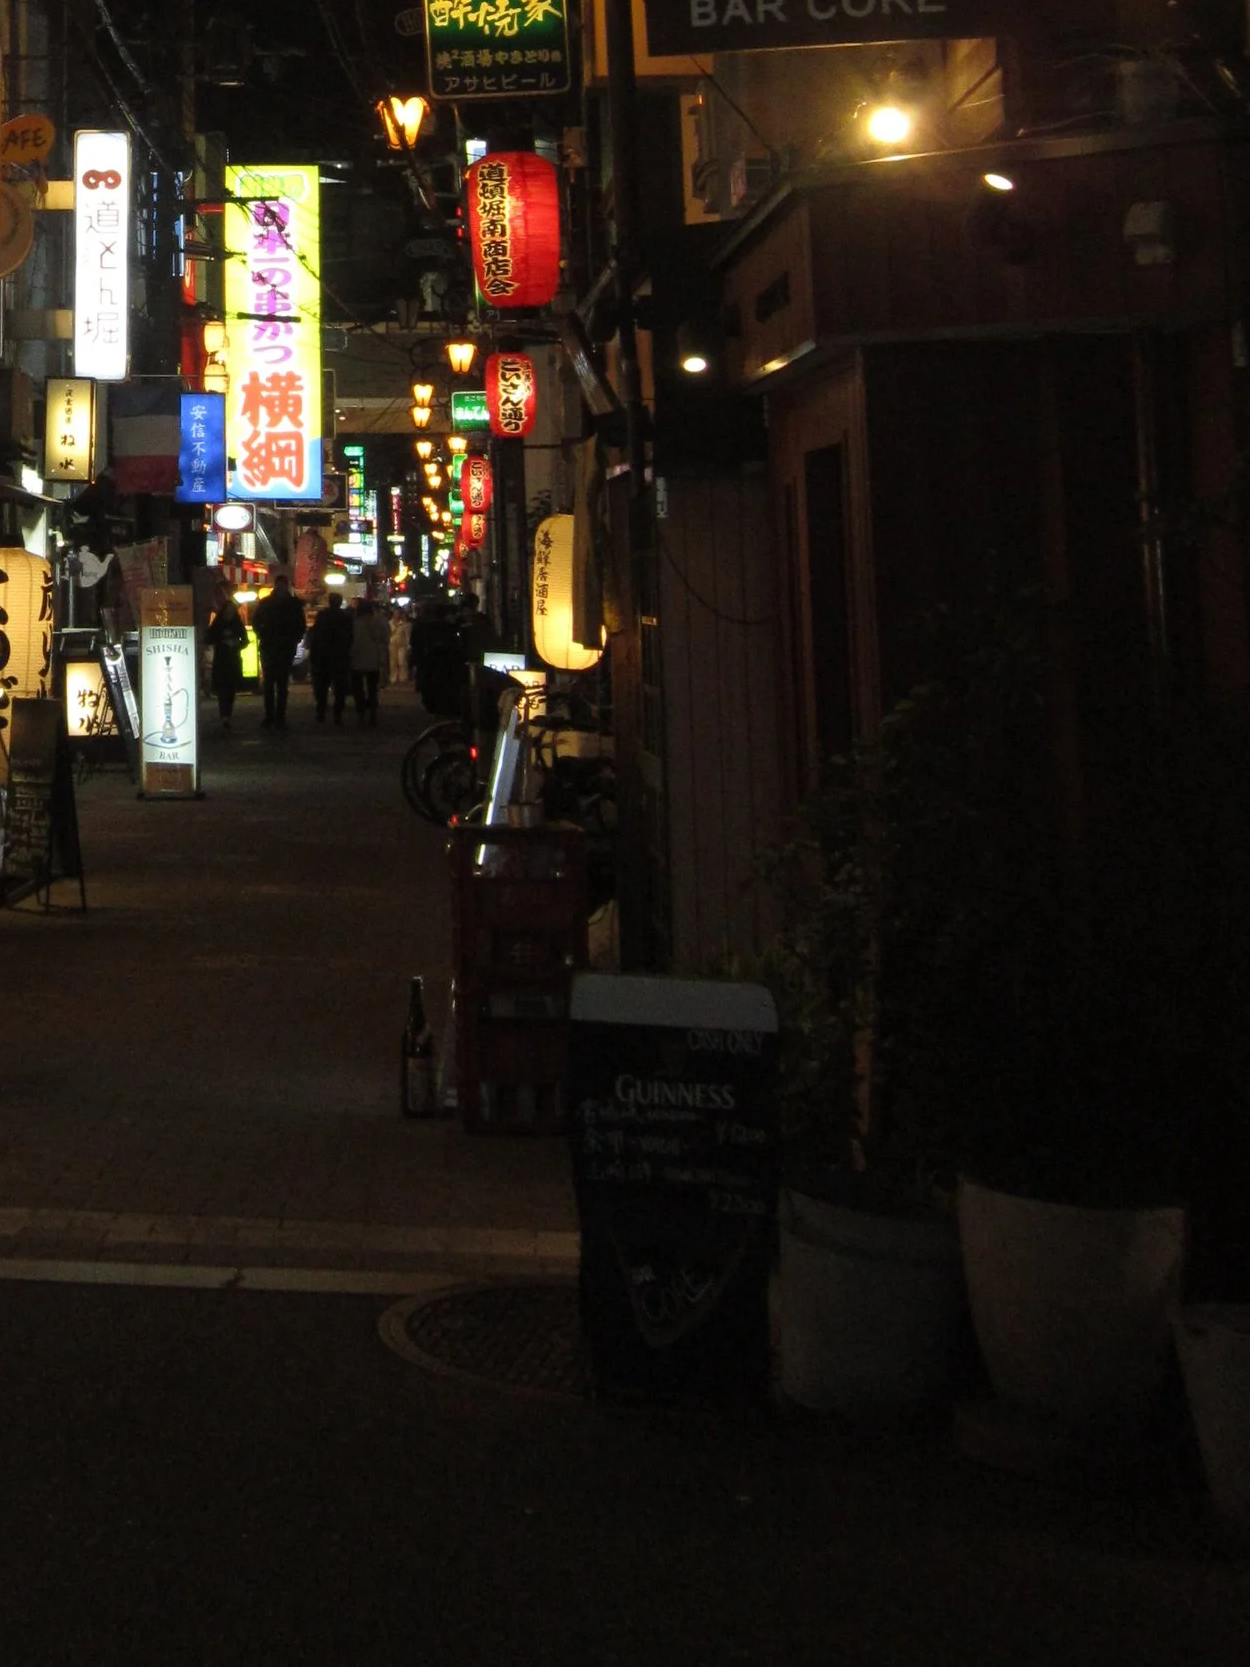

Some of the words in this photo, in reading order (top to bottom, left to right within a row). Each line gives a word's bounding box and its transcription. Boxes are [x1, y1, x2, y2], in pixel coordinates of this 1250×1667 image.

[444, 74, 556, 91] アサヒビール
[1, 126, 46, 154] AFE
[478, 162, 519, 297] 道頓堀南商店会
[83, 201, 121, 346] 道とん堀
[252, 201, 294, 365] 日本一の串かつ
[241, 370, 305, 488] 横綱
[500, 357, 525, 433] こいさん通り
[190, 404, 207, 494] 安信不動産
[535, 529, 554, 617] 海鮮居酒屋
[145, 643, 190, 657] SHISHA
[159, 751, 180, 761] BAR
[615, 1074, 736, 1110] GUINNESS
